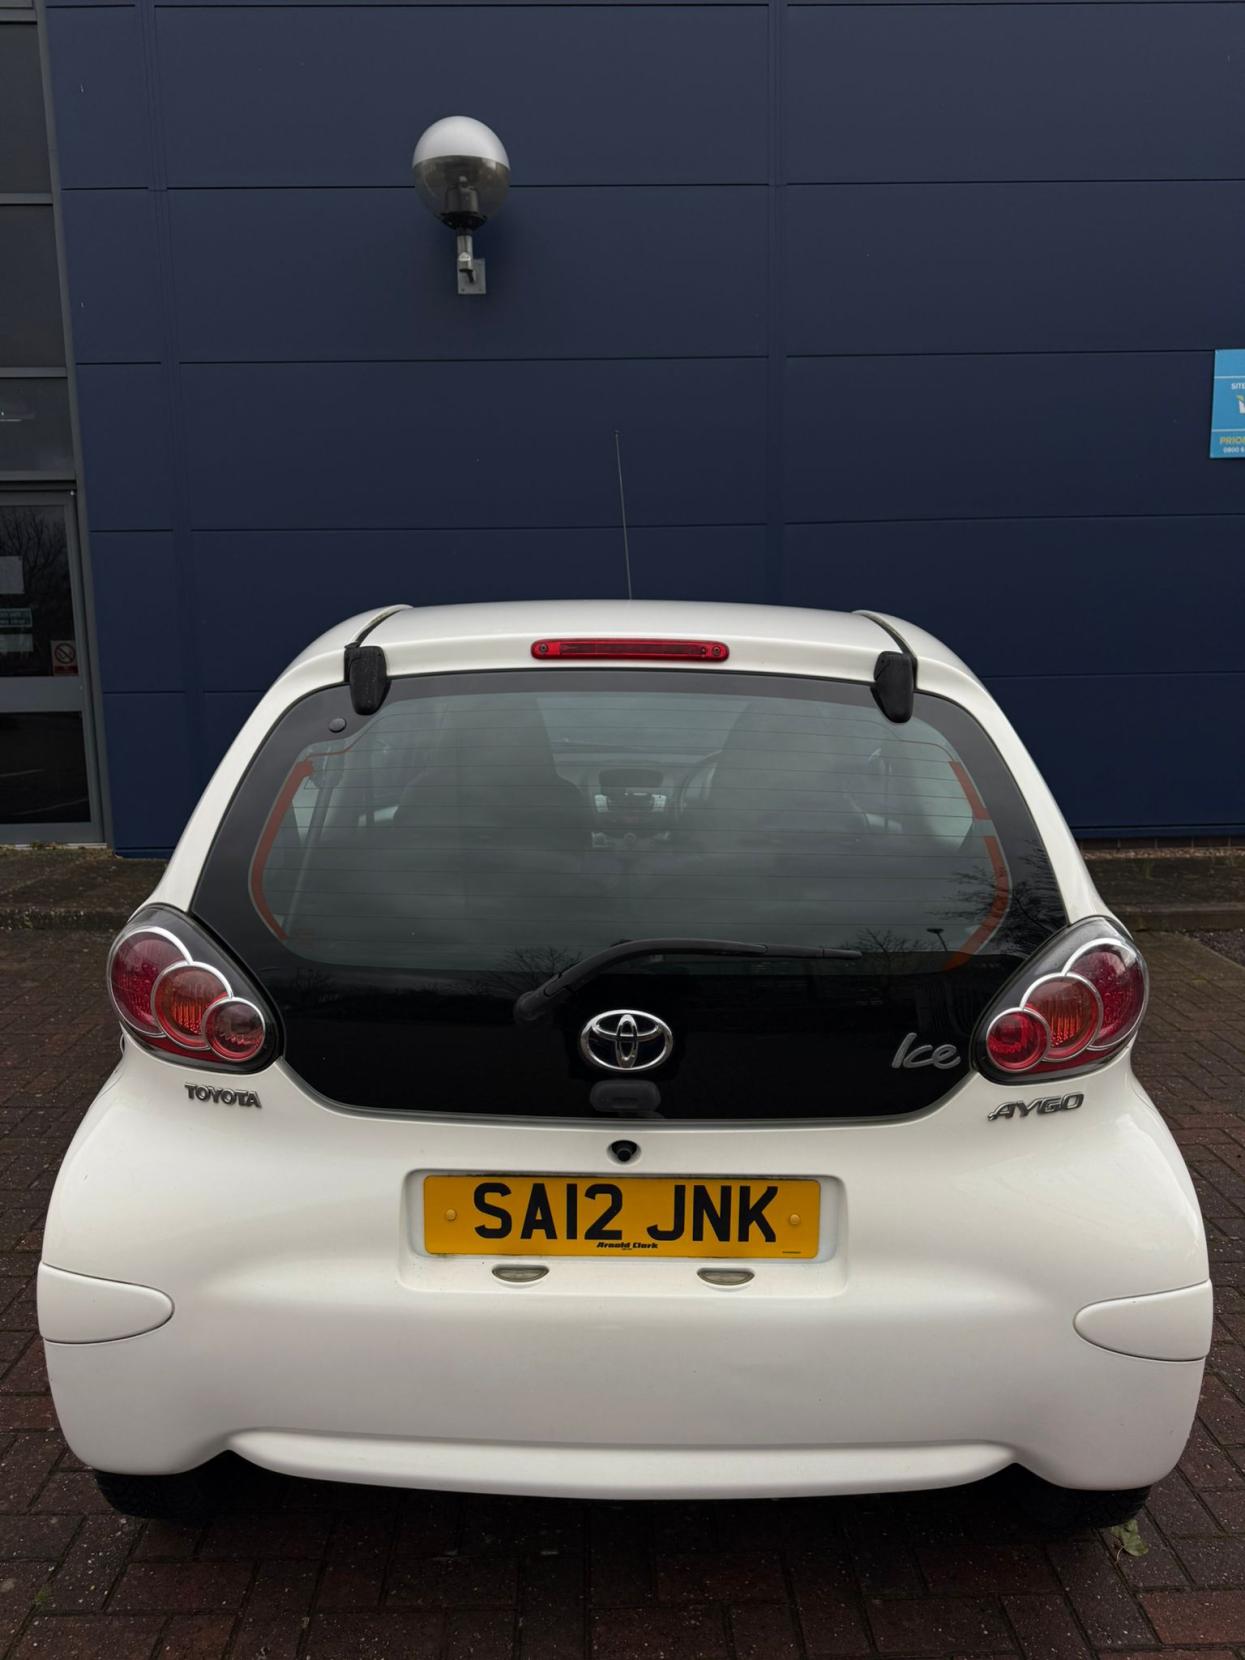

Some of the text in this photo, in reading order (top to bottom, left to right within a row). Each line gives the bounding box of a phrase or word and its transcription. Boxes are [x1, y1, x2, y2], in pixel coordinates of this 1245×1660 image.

[891, 1032, 961, 1069] Ice
[184, 1083, 262, 1109] TOYOTA
[987, 1091, 1085, 1121] AYGO
[473, 1182, 778, 1243] SA12 JNK
[596, 1241, 659, 1249] Arnold Clark
